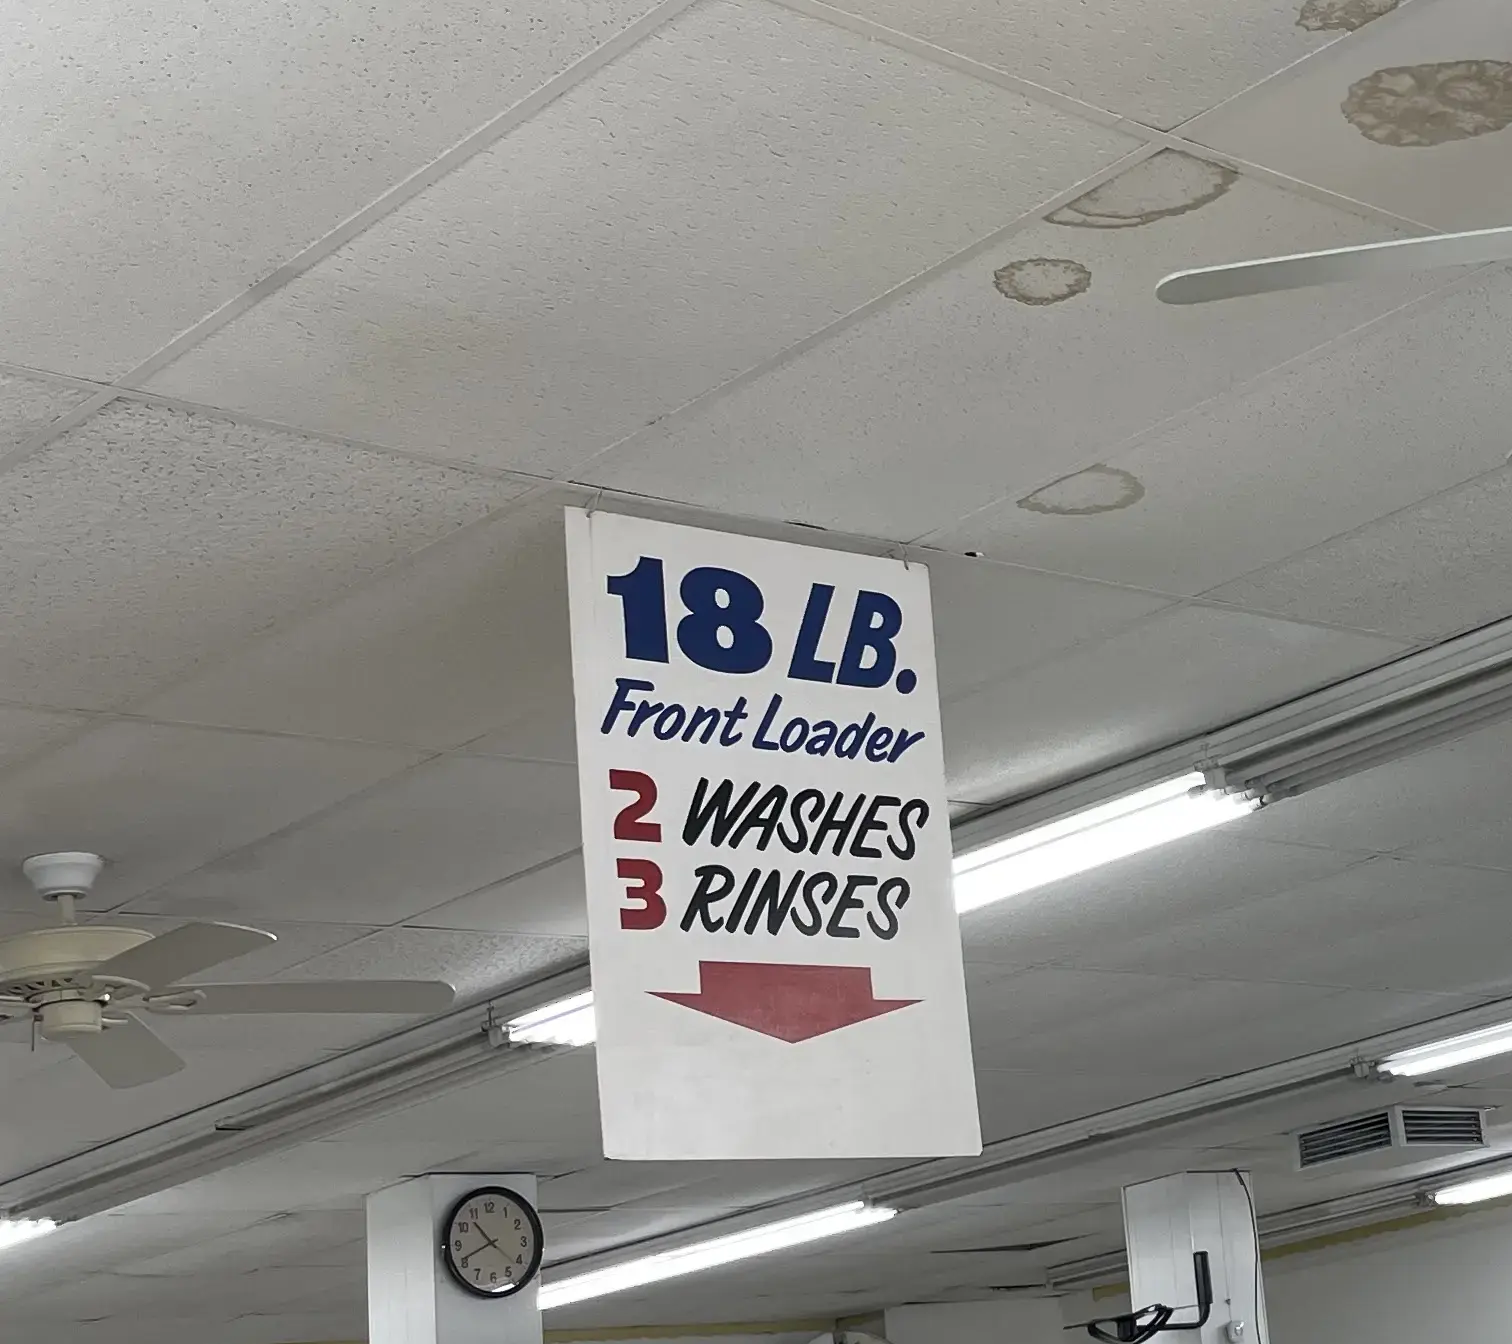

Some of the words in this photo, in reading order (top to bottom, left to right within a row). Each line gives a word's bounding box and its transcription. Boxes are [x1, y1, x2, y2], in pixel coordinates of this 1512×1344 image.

[607, 556, 772, 675] 18
[787, 583, 917, 694] LB.
[601, 677, 748, 746] Front
[752, 693, 925, 763] Loader
[610, 768, 661, 843] 2
[682, 777, 929, 861] WASHES
[617, 858, 667, 931] 3
[680, 865, 909, 941] RINSES
[484, 1202, 495, 1213] 12
[504, 1207, 507, 1218] 1
[469, 1208, 478, 1219] 11
[458, 1222, 468, 1232] 10
[514, 1219, 521, 1230] 2
[455, 1240, 461, 1251] 9
[520, 1236, 527, 1247] 3
[461, 1257, 468, 1268] 8
[516, 1254, 522, 1264] 4
[474, 1268, 480, 1280] 7
[505, 1266, 512, 1277] 5
[490, 1272, 496, 1283] 6
